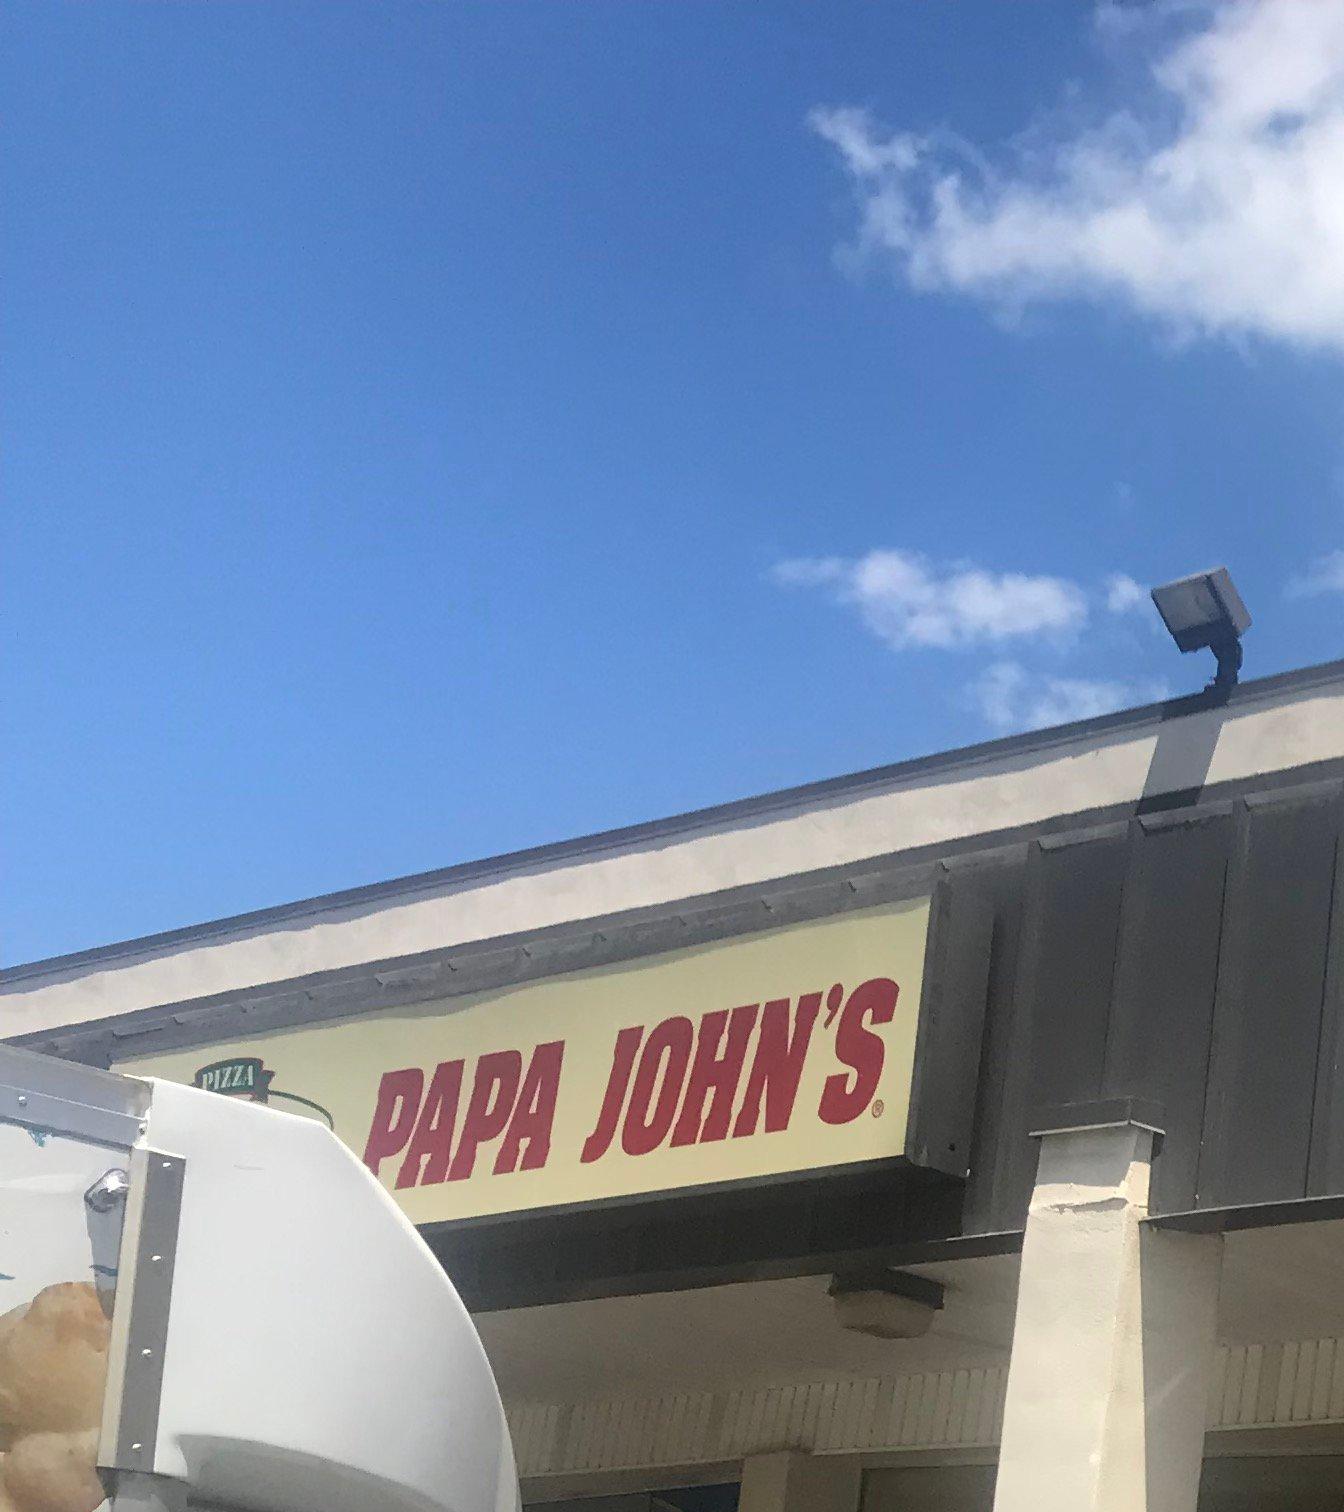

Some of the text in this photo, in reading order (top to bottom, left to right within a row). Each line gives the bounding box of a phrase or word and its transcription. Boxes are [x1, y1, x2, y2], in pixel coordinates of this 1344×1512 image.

[202, 1065, 254, 1091] PIZZA
[364, 977, 900, 1190] PAPA JOHN'S
